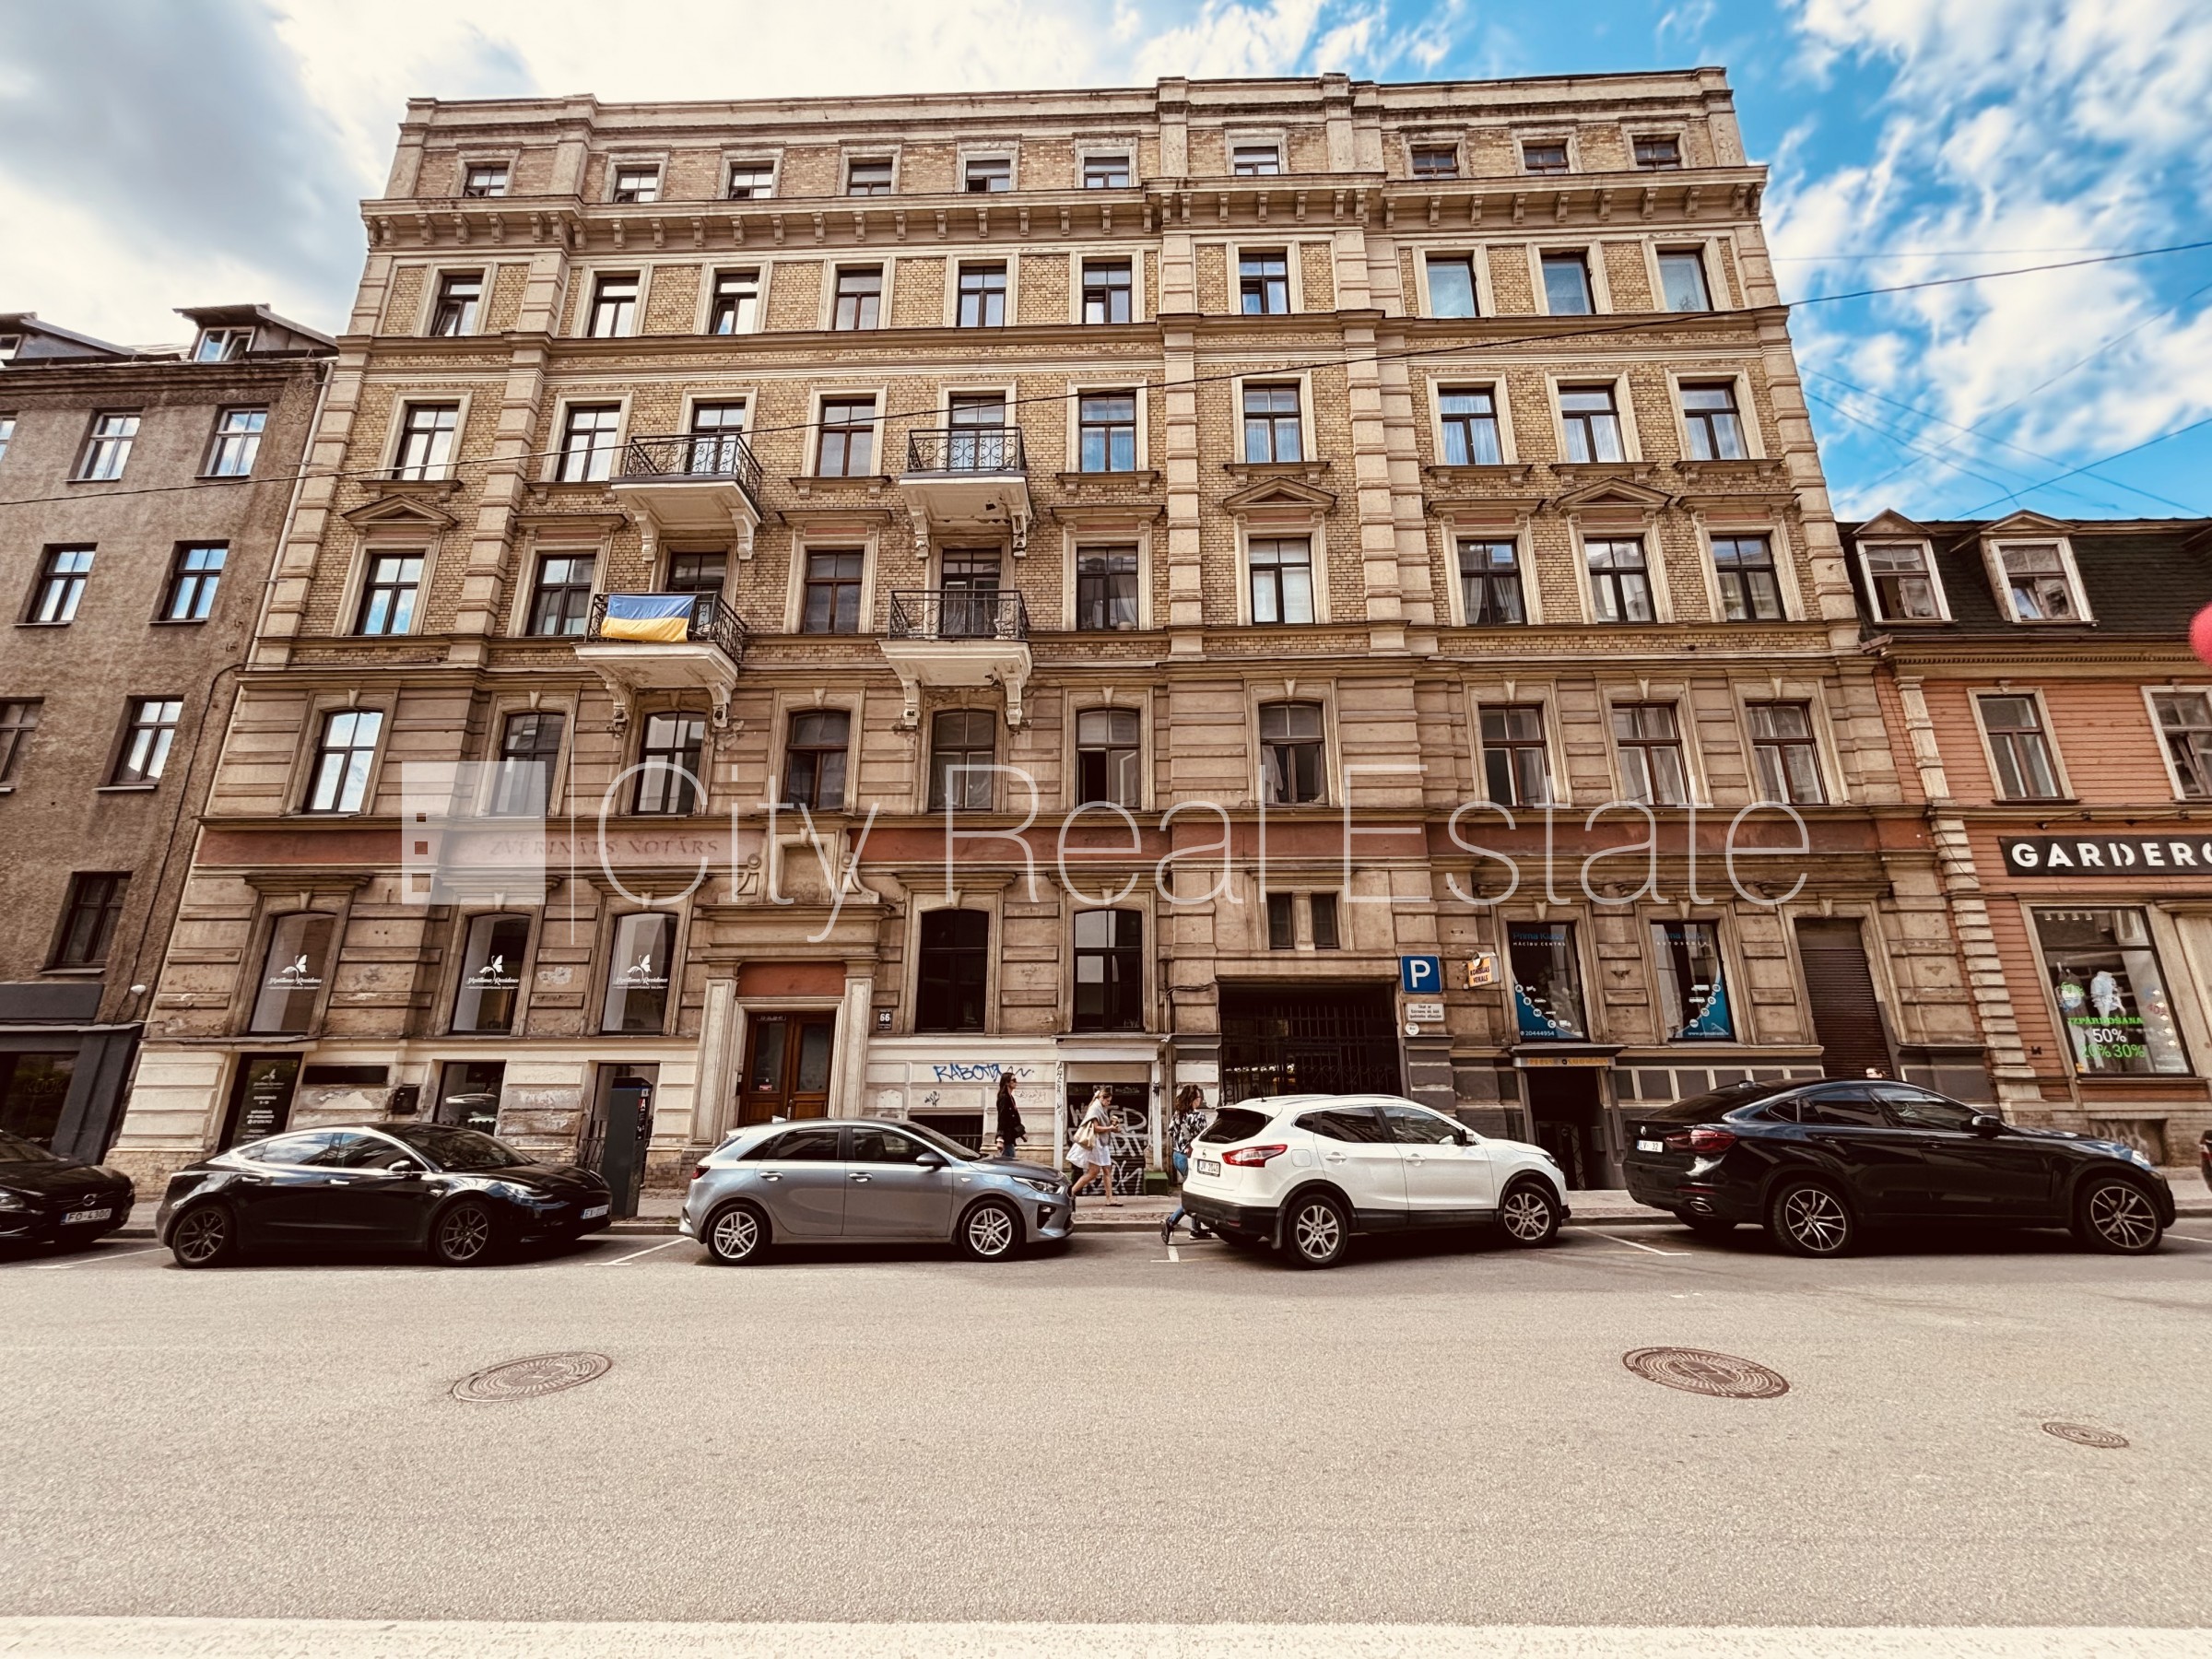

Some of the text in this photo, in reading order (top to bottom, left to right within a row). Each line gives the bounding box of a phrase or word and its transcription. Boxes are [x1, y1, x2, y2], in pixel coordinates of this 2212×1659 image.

[624, 835, 719, 855] NOTĀRS
[1409, 959, 1431, 989] P
[879, 1013, 890, 1022] 66
[2092, 1028, 2127, 1043] 50%
[2112, 1044, 2147, 1058] 30%
